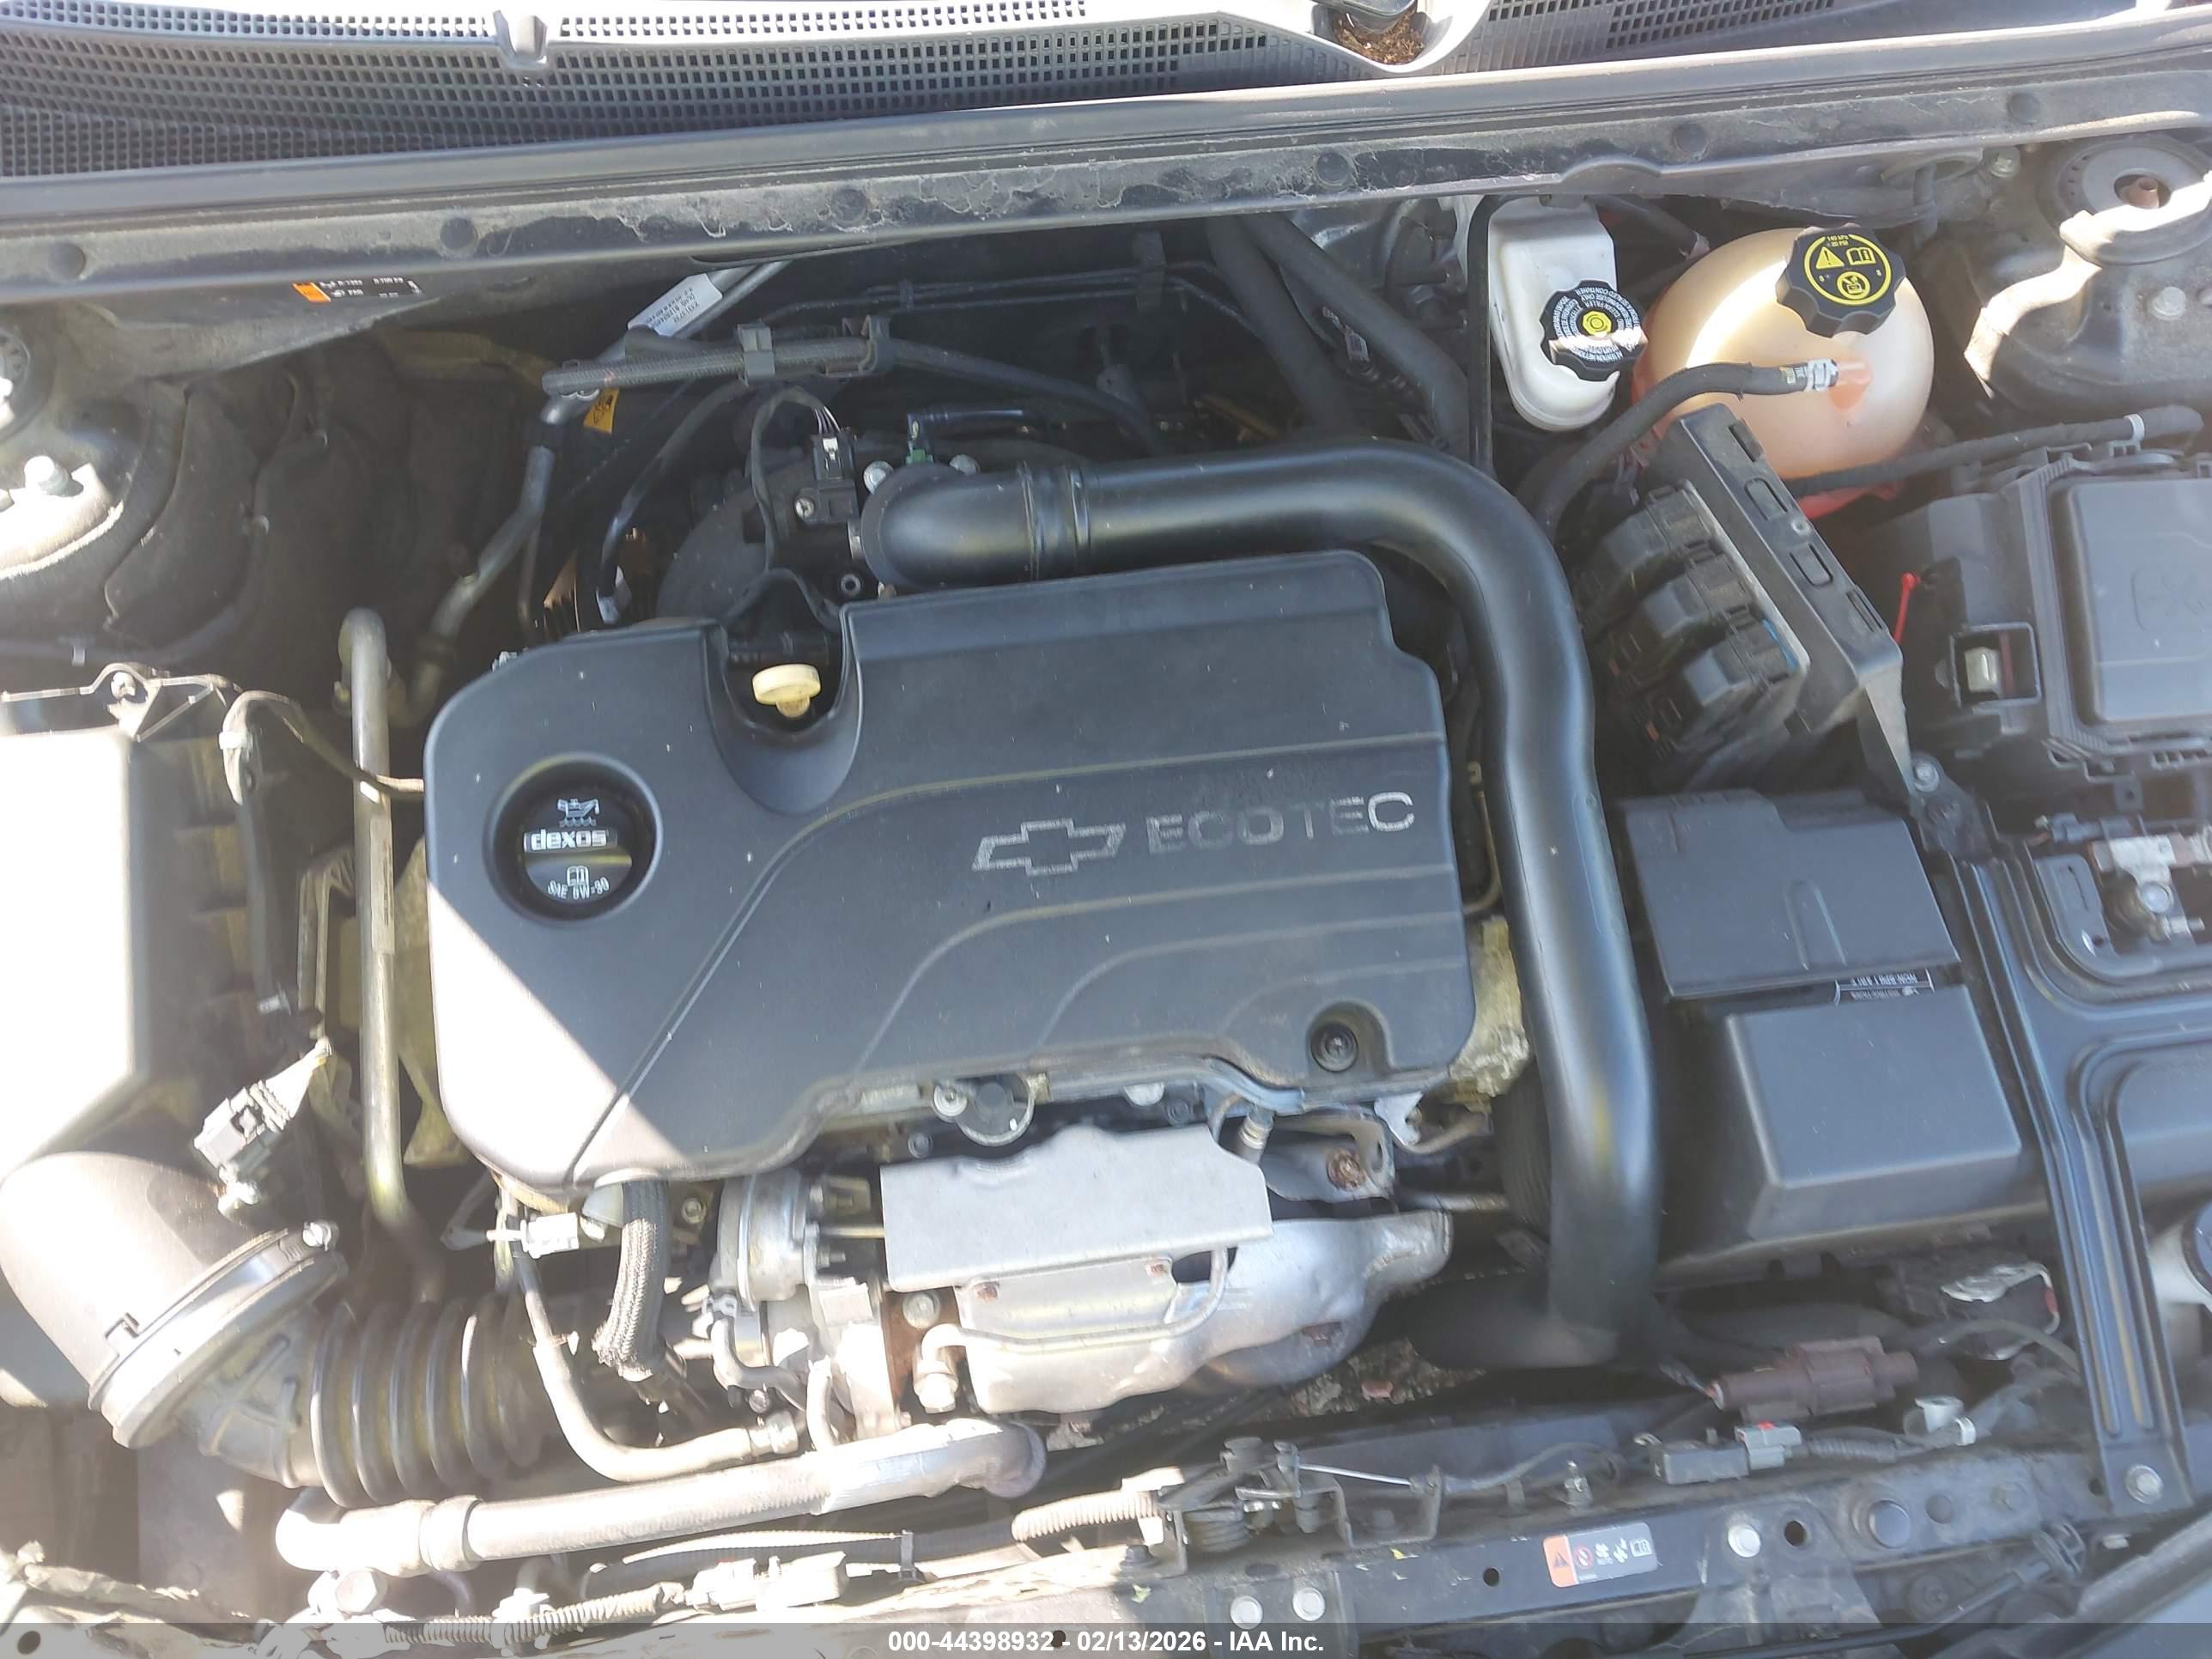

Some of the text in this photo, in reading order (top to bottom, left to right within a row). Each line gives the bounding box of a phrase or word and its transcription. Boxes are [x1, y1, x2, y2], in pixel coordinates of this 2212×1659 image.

[1575, 286, 1609, 297] CONTAINER
[1146, 791, 1415, 855] ECOTEC
[531, 829, 607, 851] dexos
